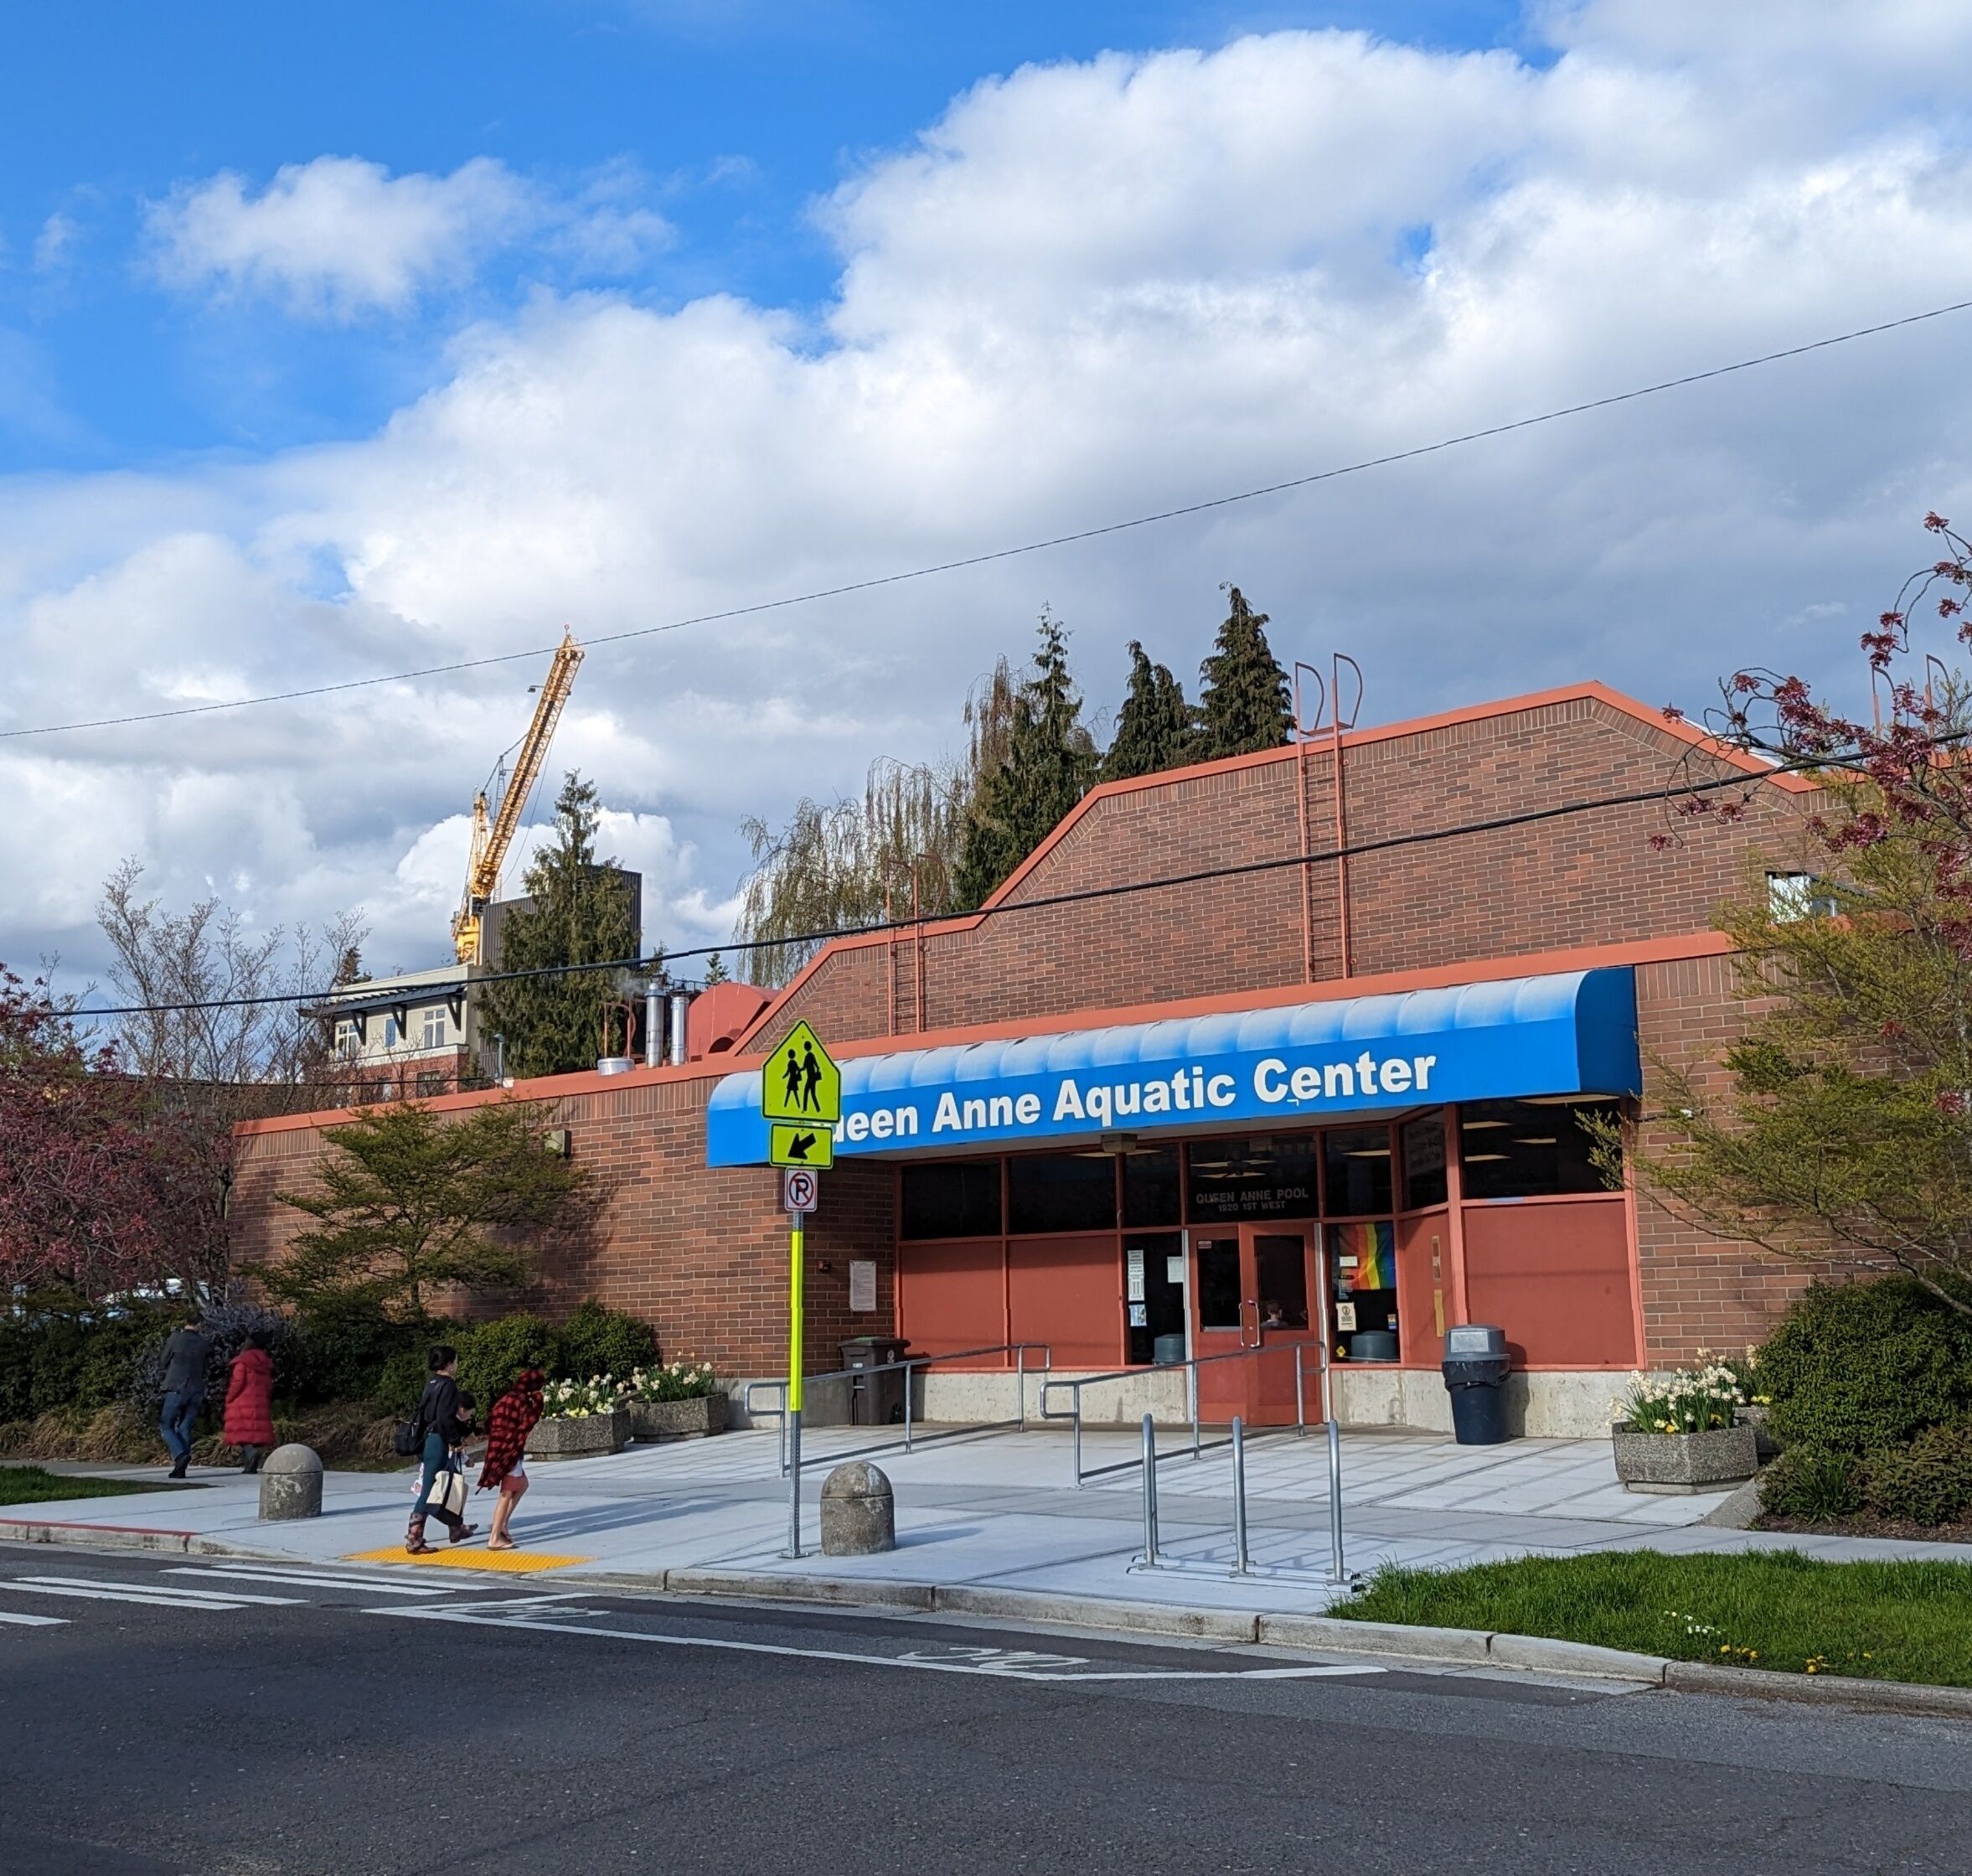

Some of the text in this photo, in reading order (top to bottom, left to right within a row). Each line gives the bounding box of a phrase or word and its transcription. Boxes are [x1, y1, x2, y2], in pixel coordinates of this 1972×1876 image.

[833, 1050, 1437, 1143] een Anne Aquatic Center
[1196, 1188, 1309, 1204] QUEEN ANNE POOL
[1218, 1201, 1286, 1212] 1920 1ST WEST
